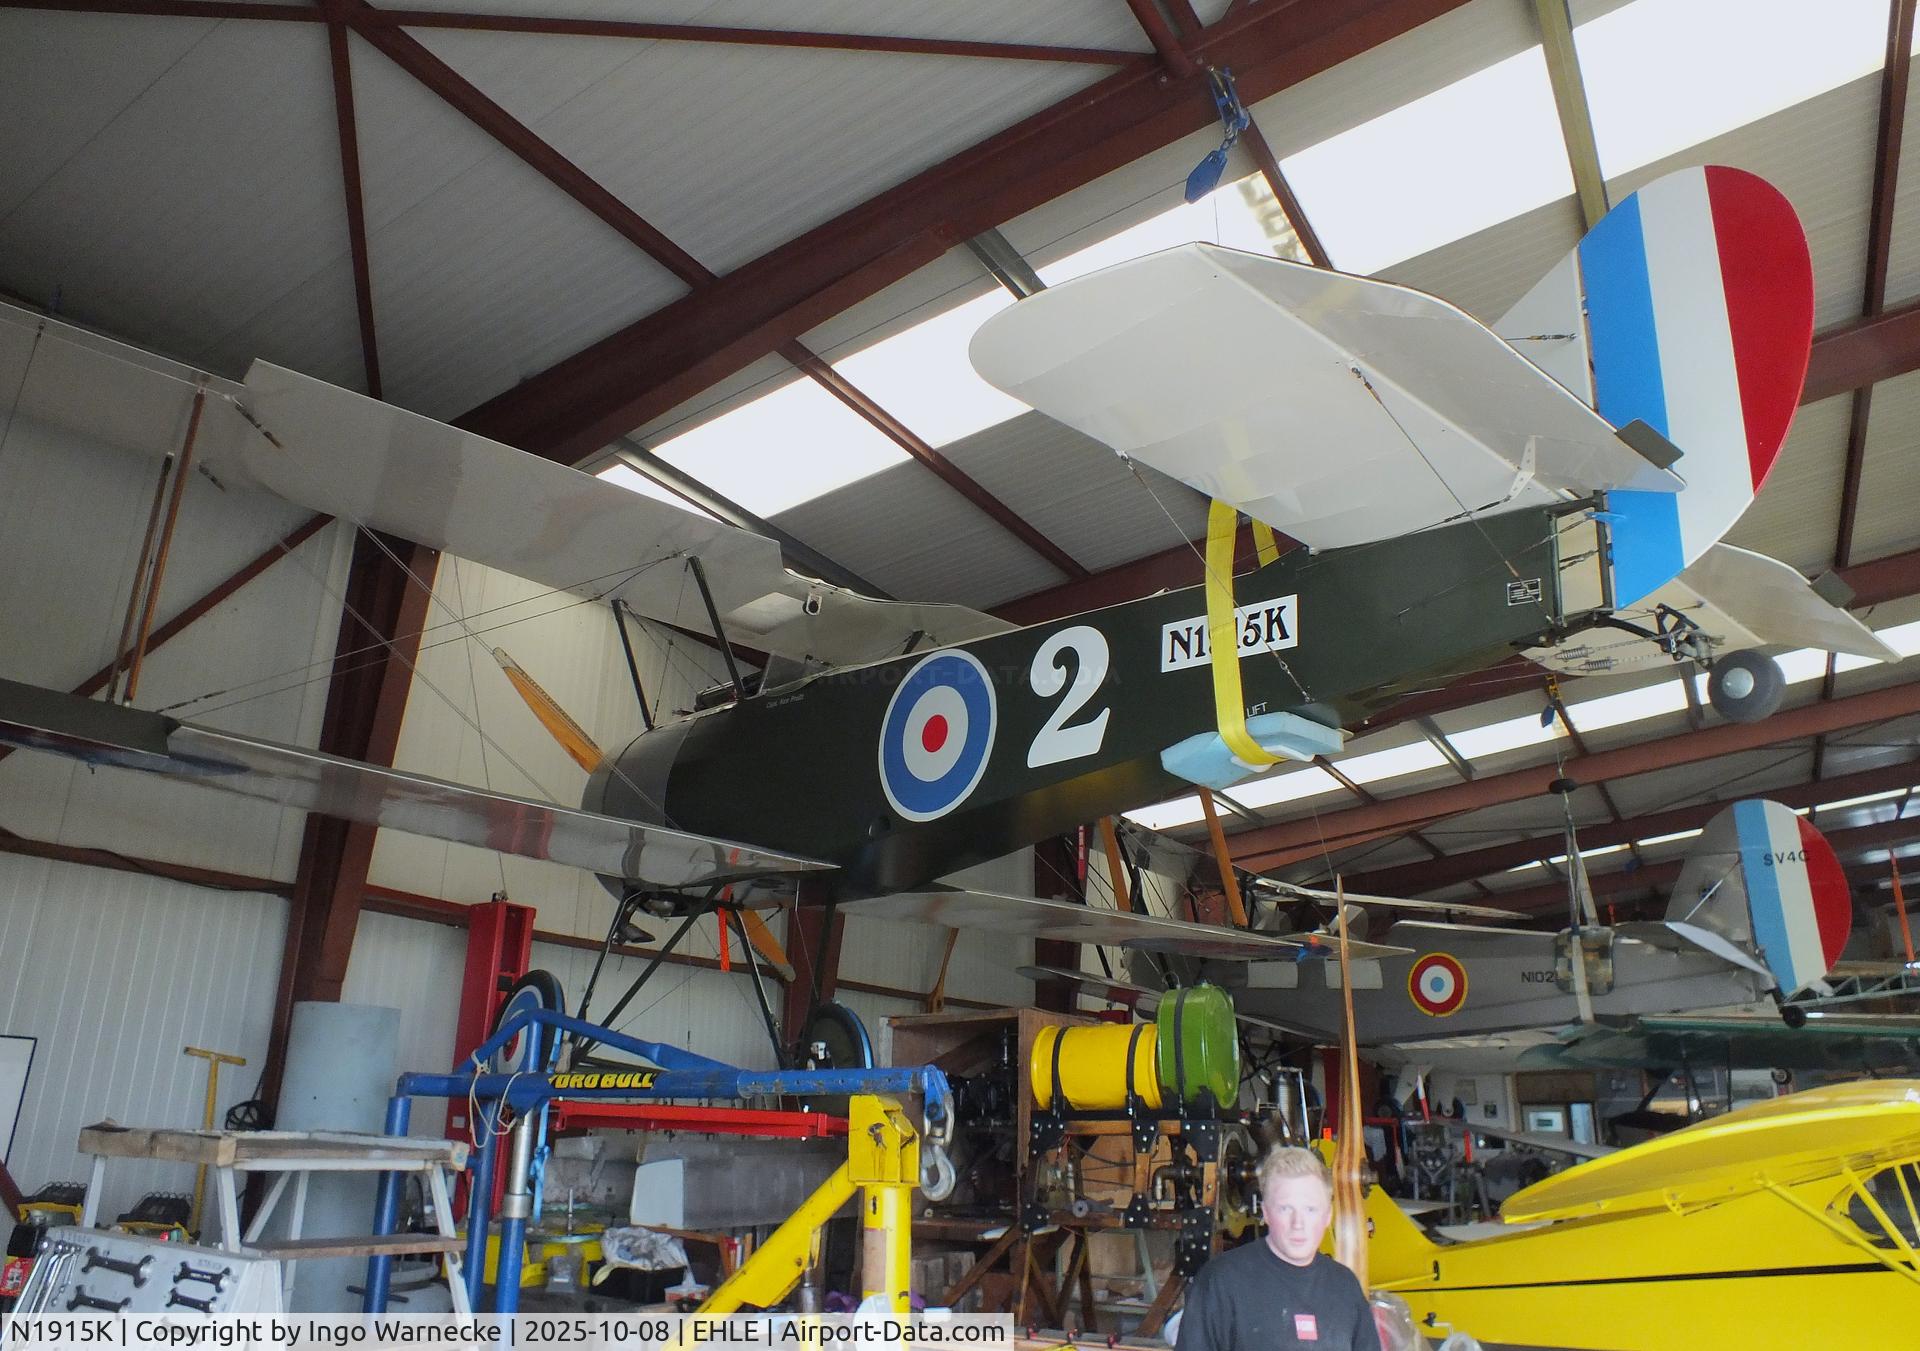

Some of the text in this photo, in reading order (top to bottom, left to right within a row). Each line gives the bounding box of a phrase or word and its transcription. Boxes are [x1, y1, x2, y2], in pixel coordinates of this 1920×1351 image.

[1168, 604, 1290, 664] N15K
[1027, 625, 1111, 769] 2
[1246, 701, 1268, 718] LIFT
